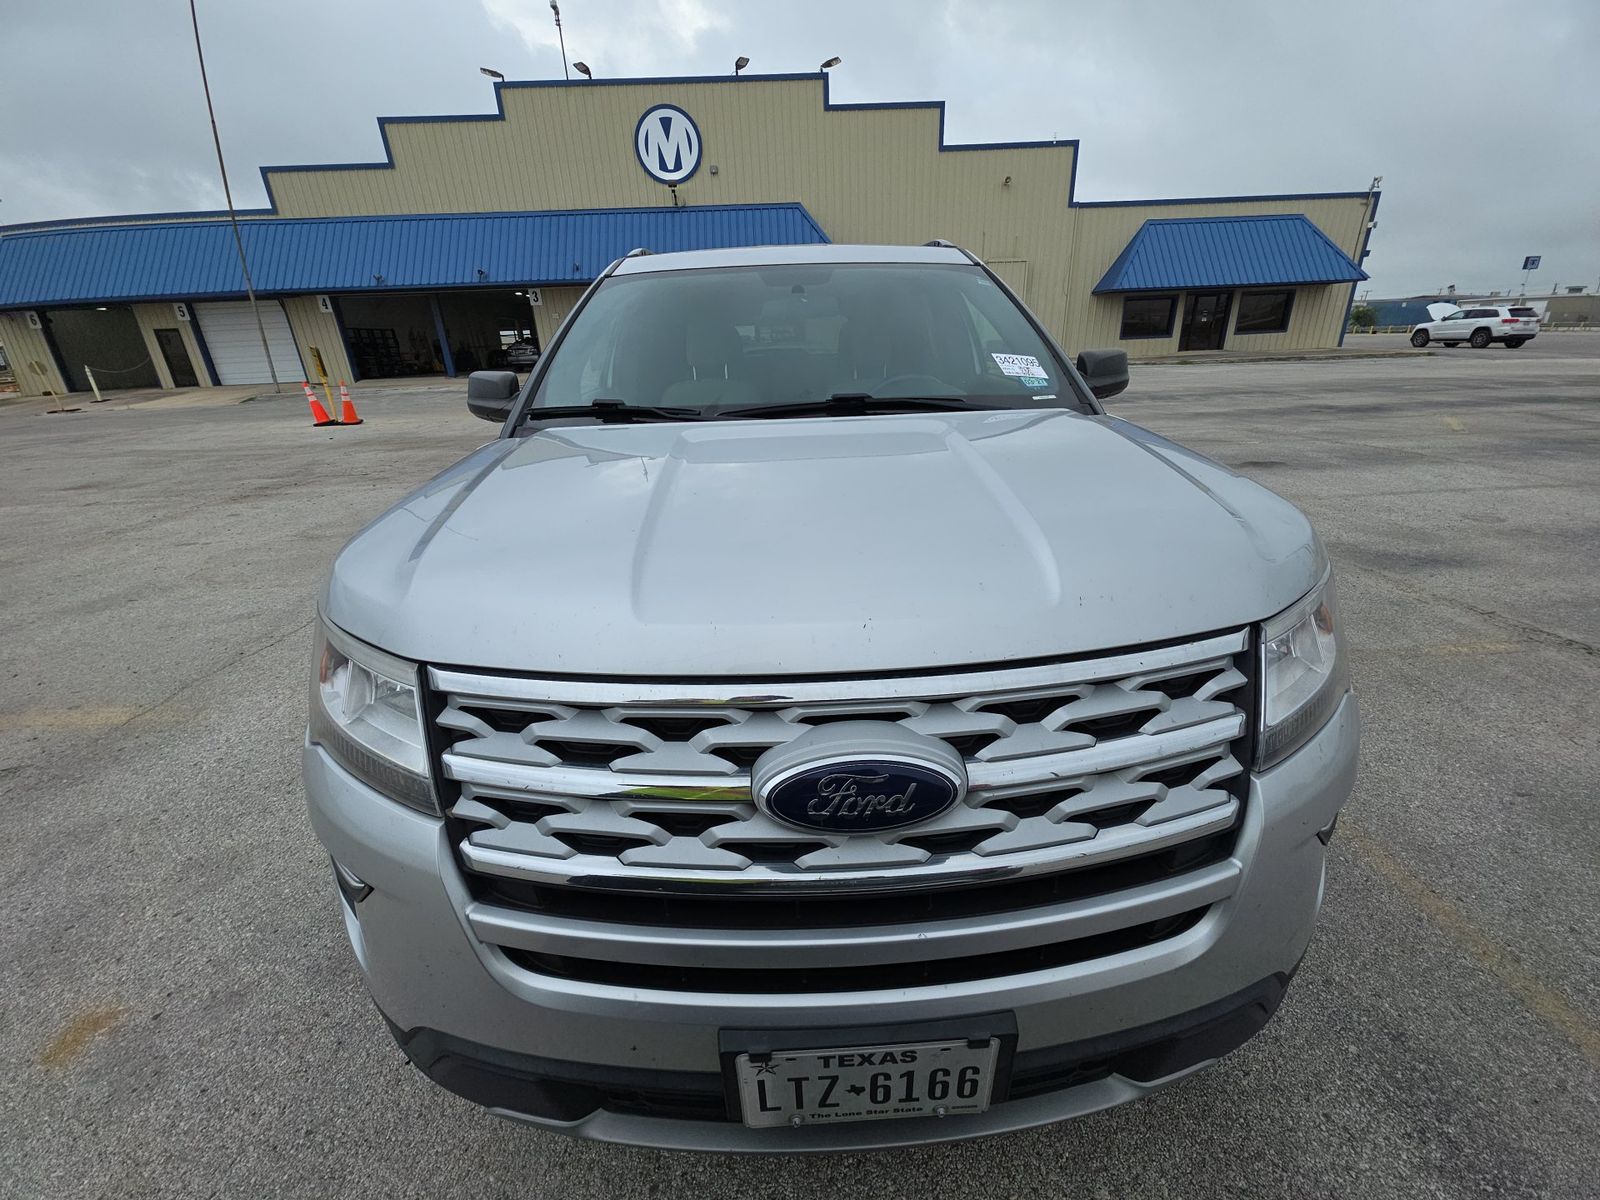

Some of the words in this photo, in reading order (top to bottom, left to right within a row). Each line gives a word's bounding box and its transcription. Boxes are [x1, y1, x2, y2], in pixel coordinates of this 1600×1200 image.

[641, 111, 695, 177] M
[532, 290, 539, 302] 3
[321, 298, 329, 309] 4
[177, 306, 186, 317] 5
[29, 314, 37, 326] 6
[995, 355, 1041, 367] 3421095
[807, 773, 917, 817] Ford
[817, 1050, 918, 1069] TEXAS
[757, 1075, 840, 1112] LTZ
[869, 1065, 981, 1105] 6166
